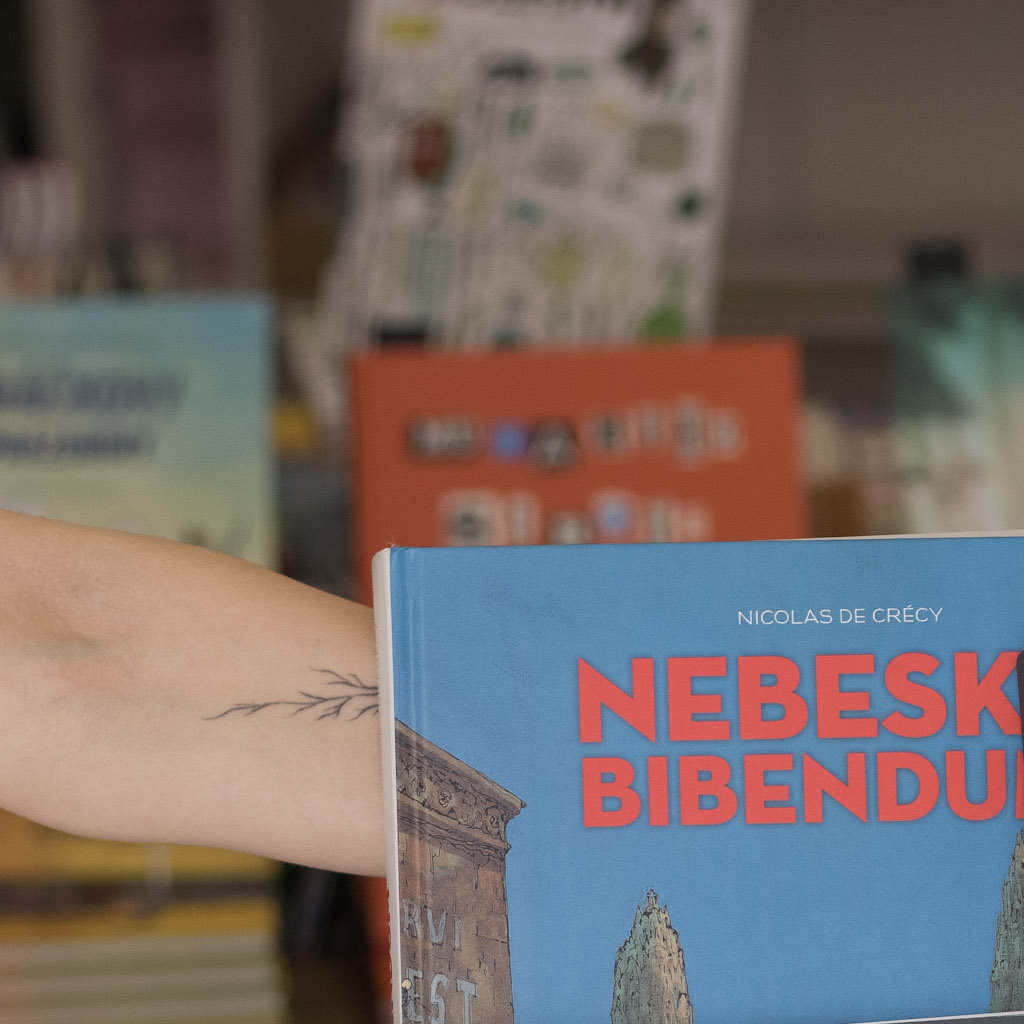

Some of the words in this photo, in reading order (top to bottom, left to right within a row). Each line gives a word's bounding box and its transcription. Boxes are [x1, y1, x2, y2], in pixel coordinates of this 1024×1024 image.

[737, 608, 833, 626] NICOLAS
[838, 607, 867, 625] DE
[871, 604, 944, 624] CRÉCY
